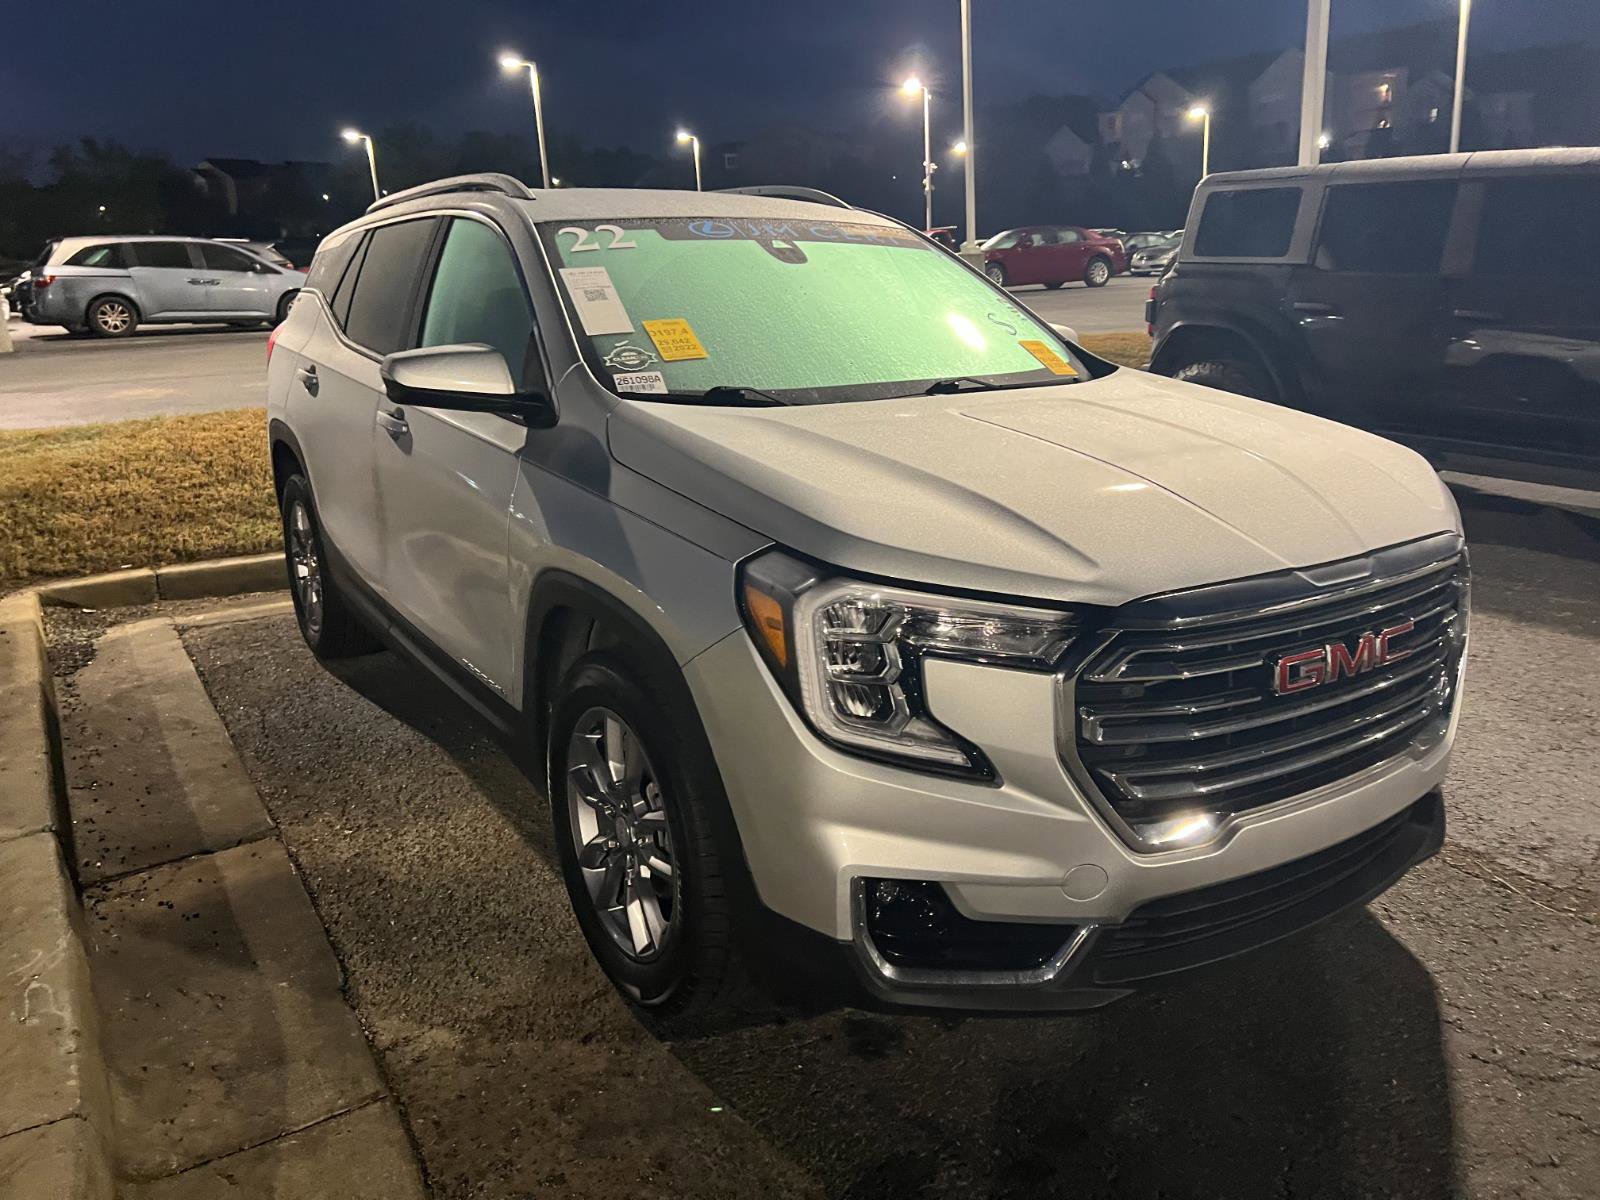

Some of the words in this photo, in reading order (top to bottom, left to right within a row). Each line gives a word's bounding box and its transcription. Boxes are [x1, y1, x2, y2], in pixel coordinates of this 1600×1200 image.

[558, 224, 638, 252] 22
[616, 375, 662, 386] 261098A
[1273, 617, 1415, 697] GMC
